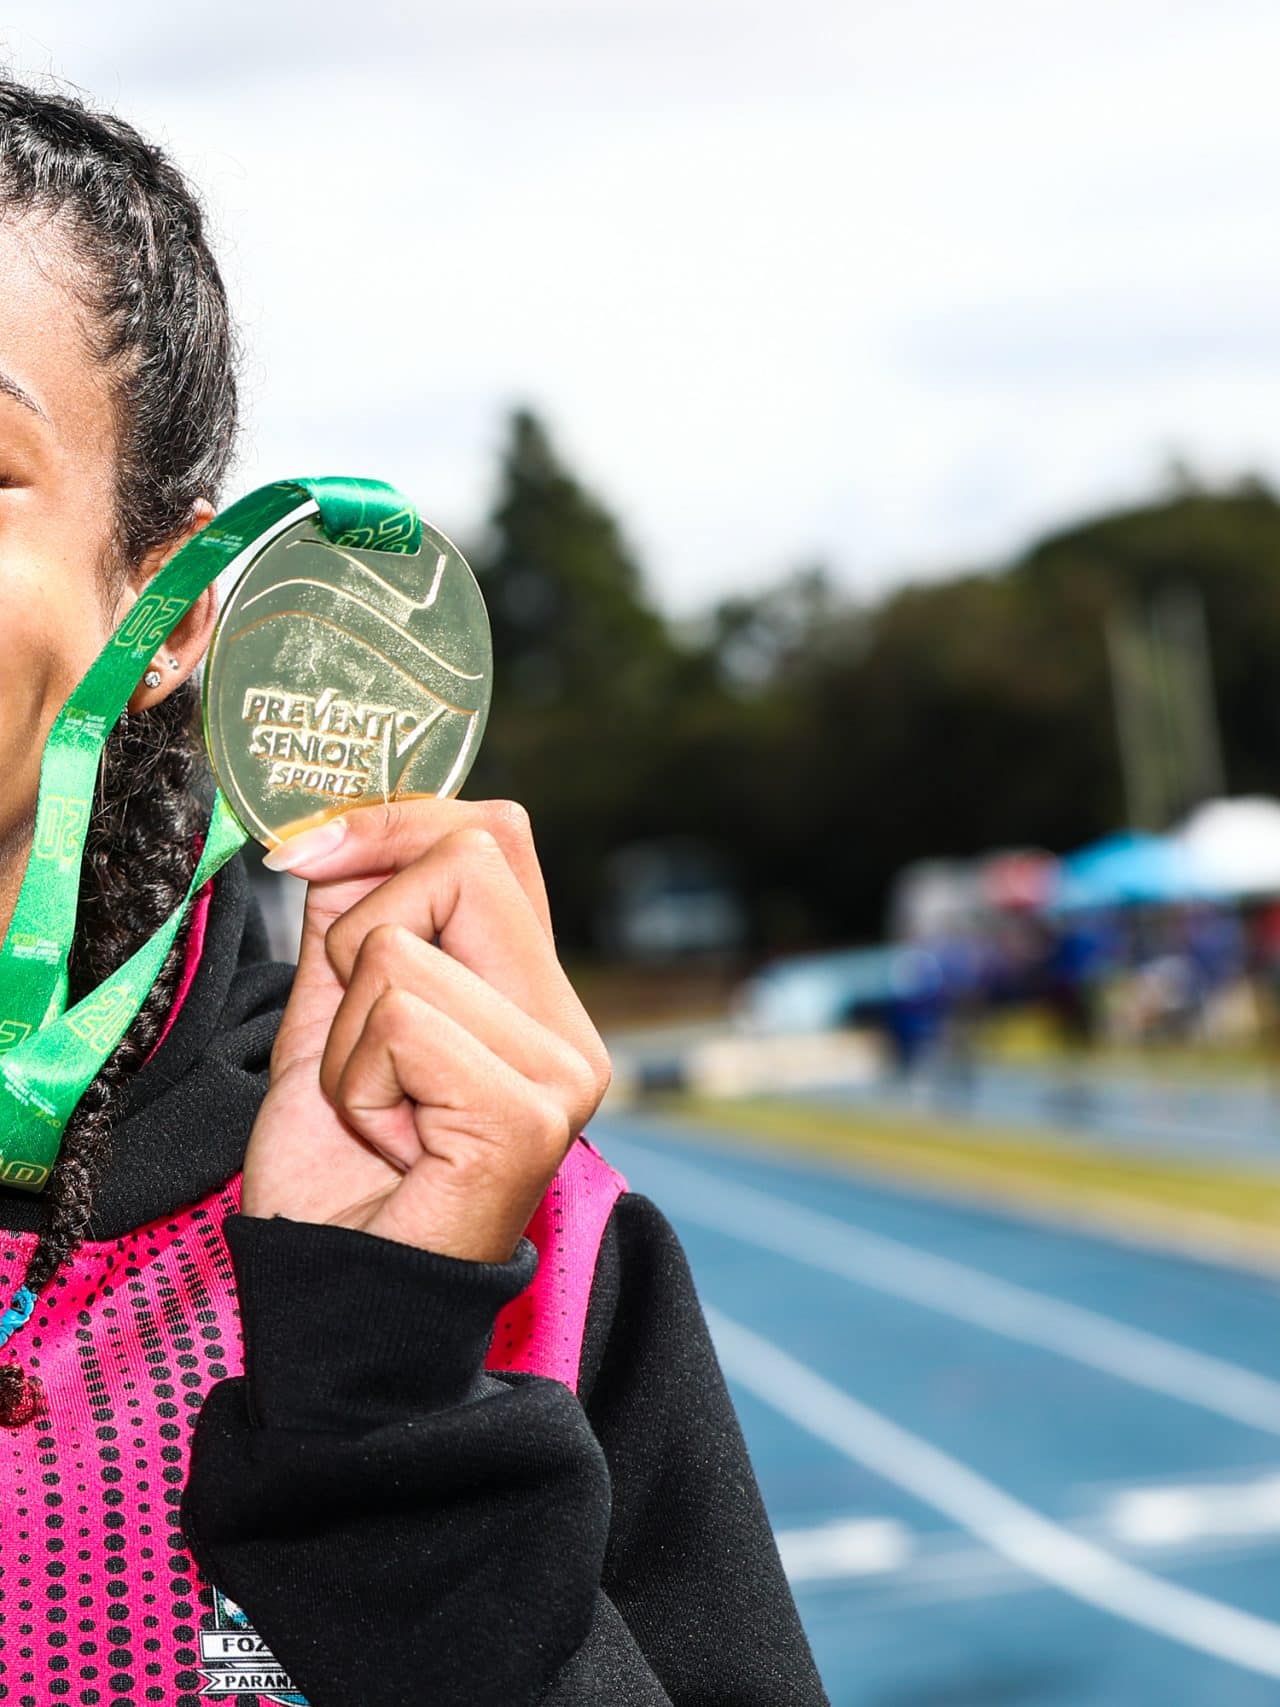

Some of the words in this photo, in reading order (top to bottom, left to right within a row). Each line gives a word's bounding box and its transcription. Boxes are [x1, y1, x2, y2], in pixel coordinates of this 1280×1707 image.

[242, 687, 393, 740] PREVENT
[250, 725, 373, 773] SENIOR
[269, 762, 369, 798] SPORTS
[225, 1674, 297, 1689] PARAN
